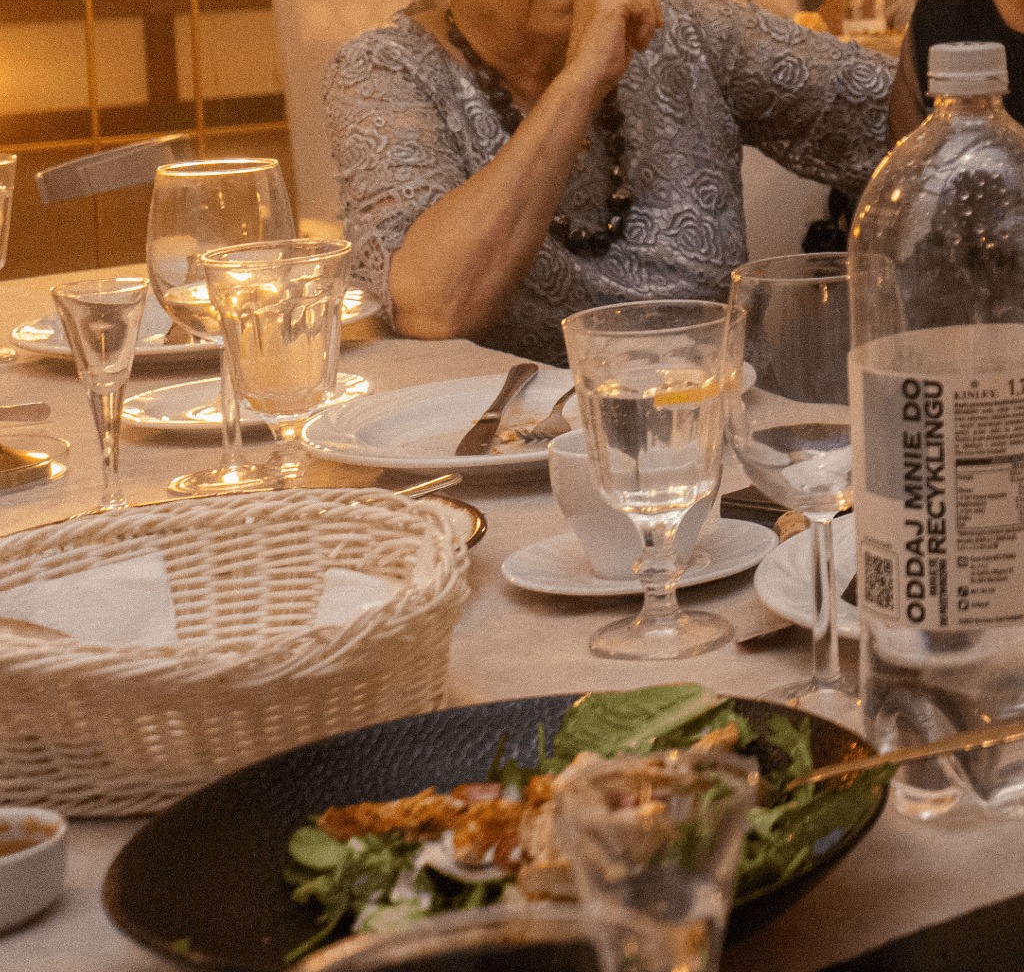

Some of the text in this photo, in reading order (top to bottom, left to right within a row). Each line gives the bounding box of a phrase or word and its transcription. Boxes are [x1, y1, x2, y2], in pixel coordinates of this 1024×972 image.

[902, 378, 927, 624] ODDAJ MNIE DO
[925, 380, 947, 555] RECYKLINGU
